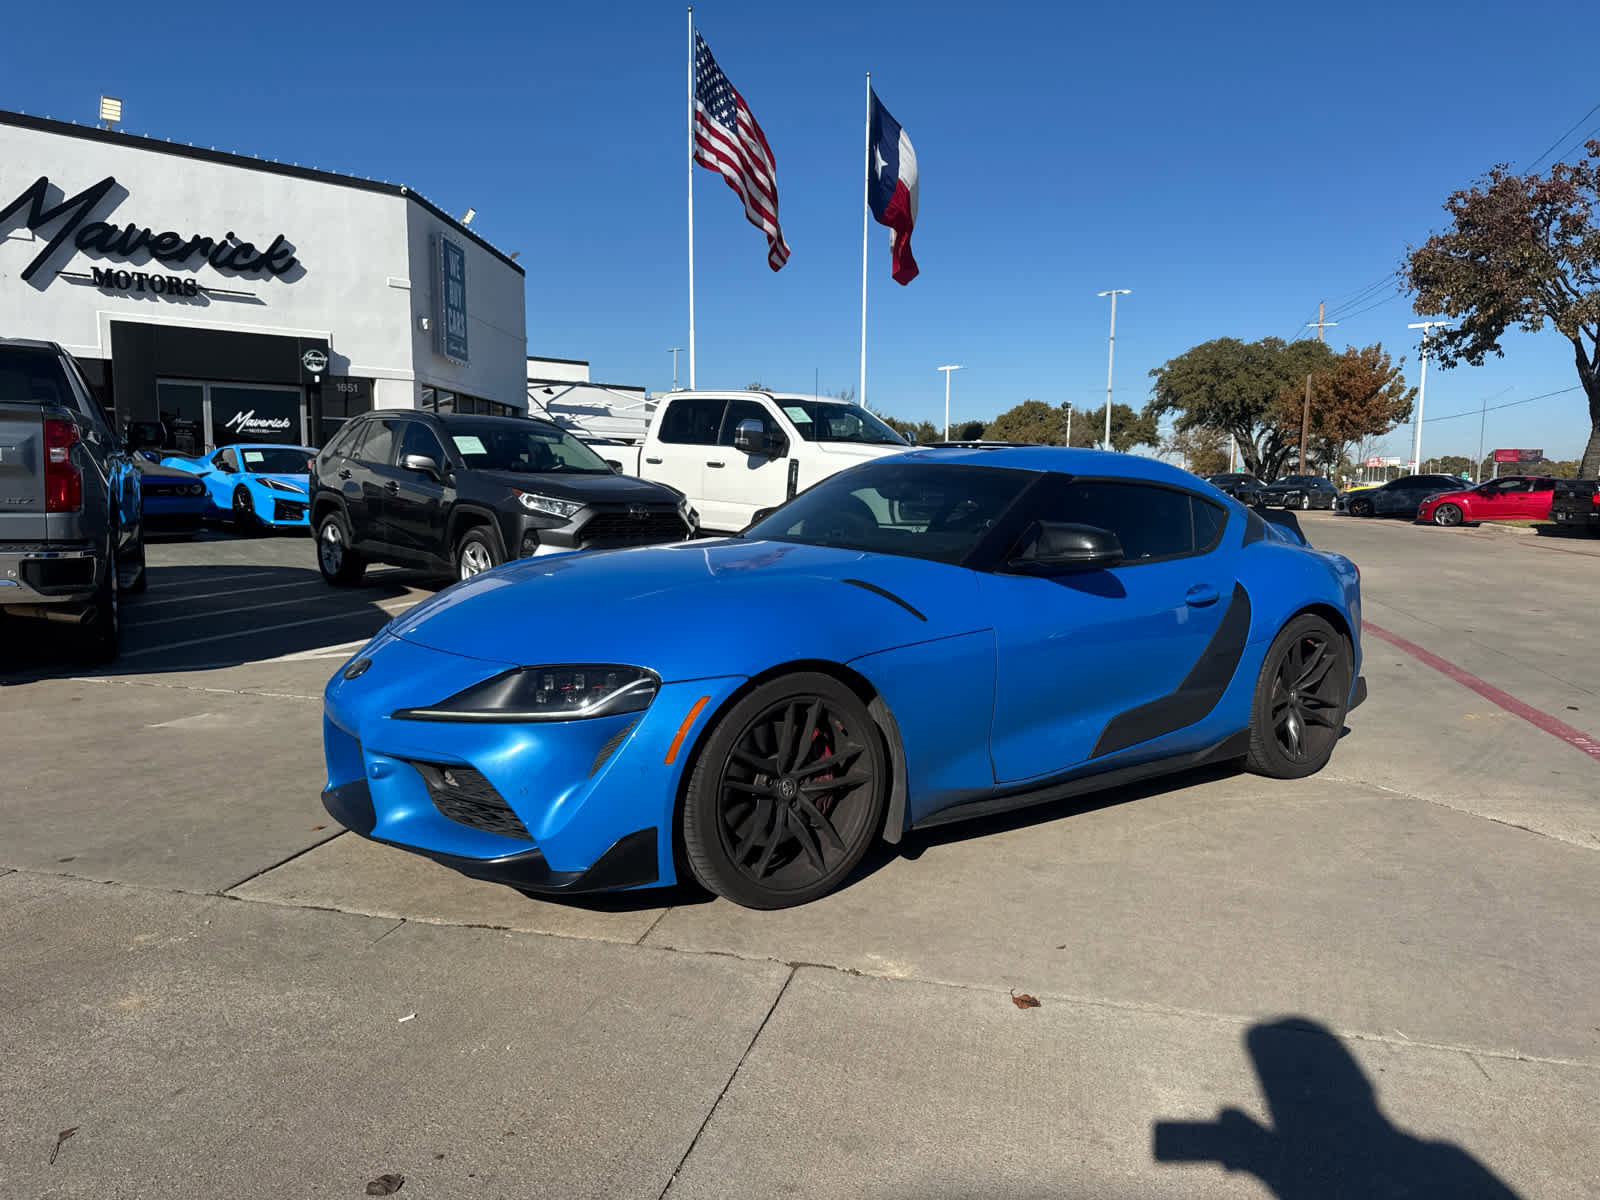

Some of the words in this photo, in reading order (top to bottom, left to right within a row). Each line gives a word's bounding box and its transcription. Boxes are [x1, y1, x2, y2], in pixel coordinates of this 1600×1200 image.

[0, 176, 297, 281] Maverick
[90, 266, 199, 297] MOTORS
[336, 383, 358, 393] 1651
[225, 409, 291, 434] Maverick
